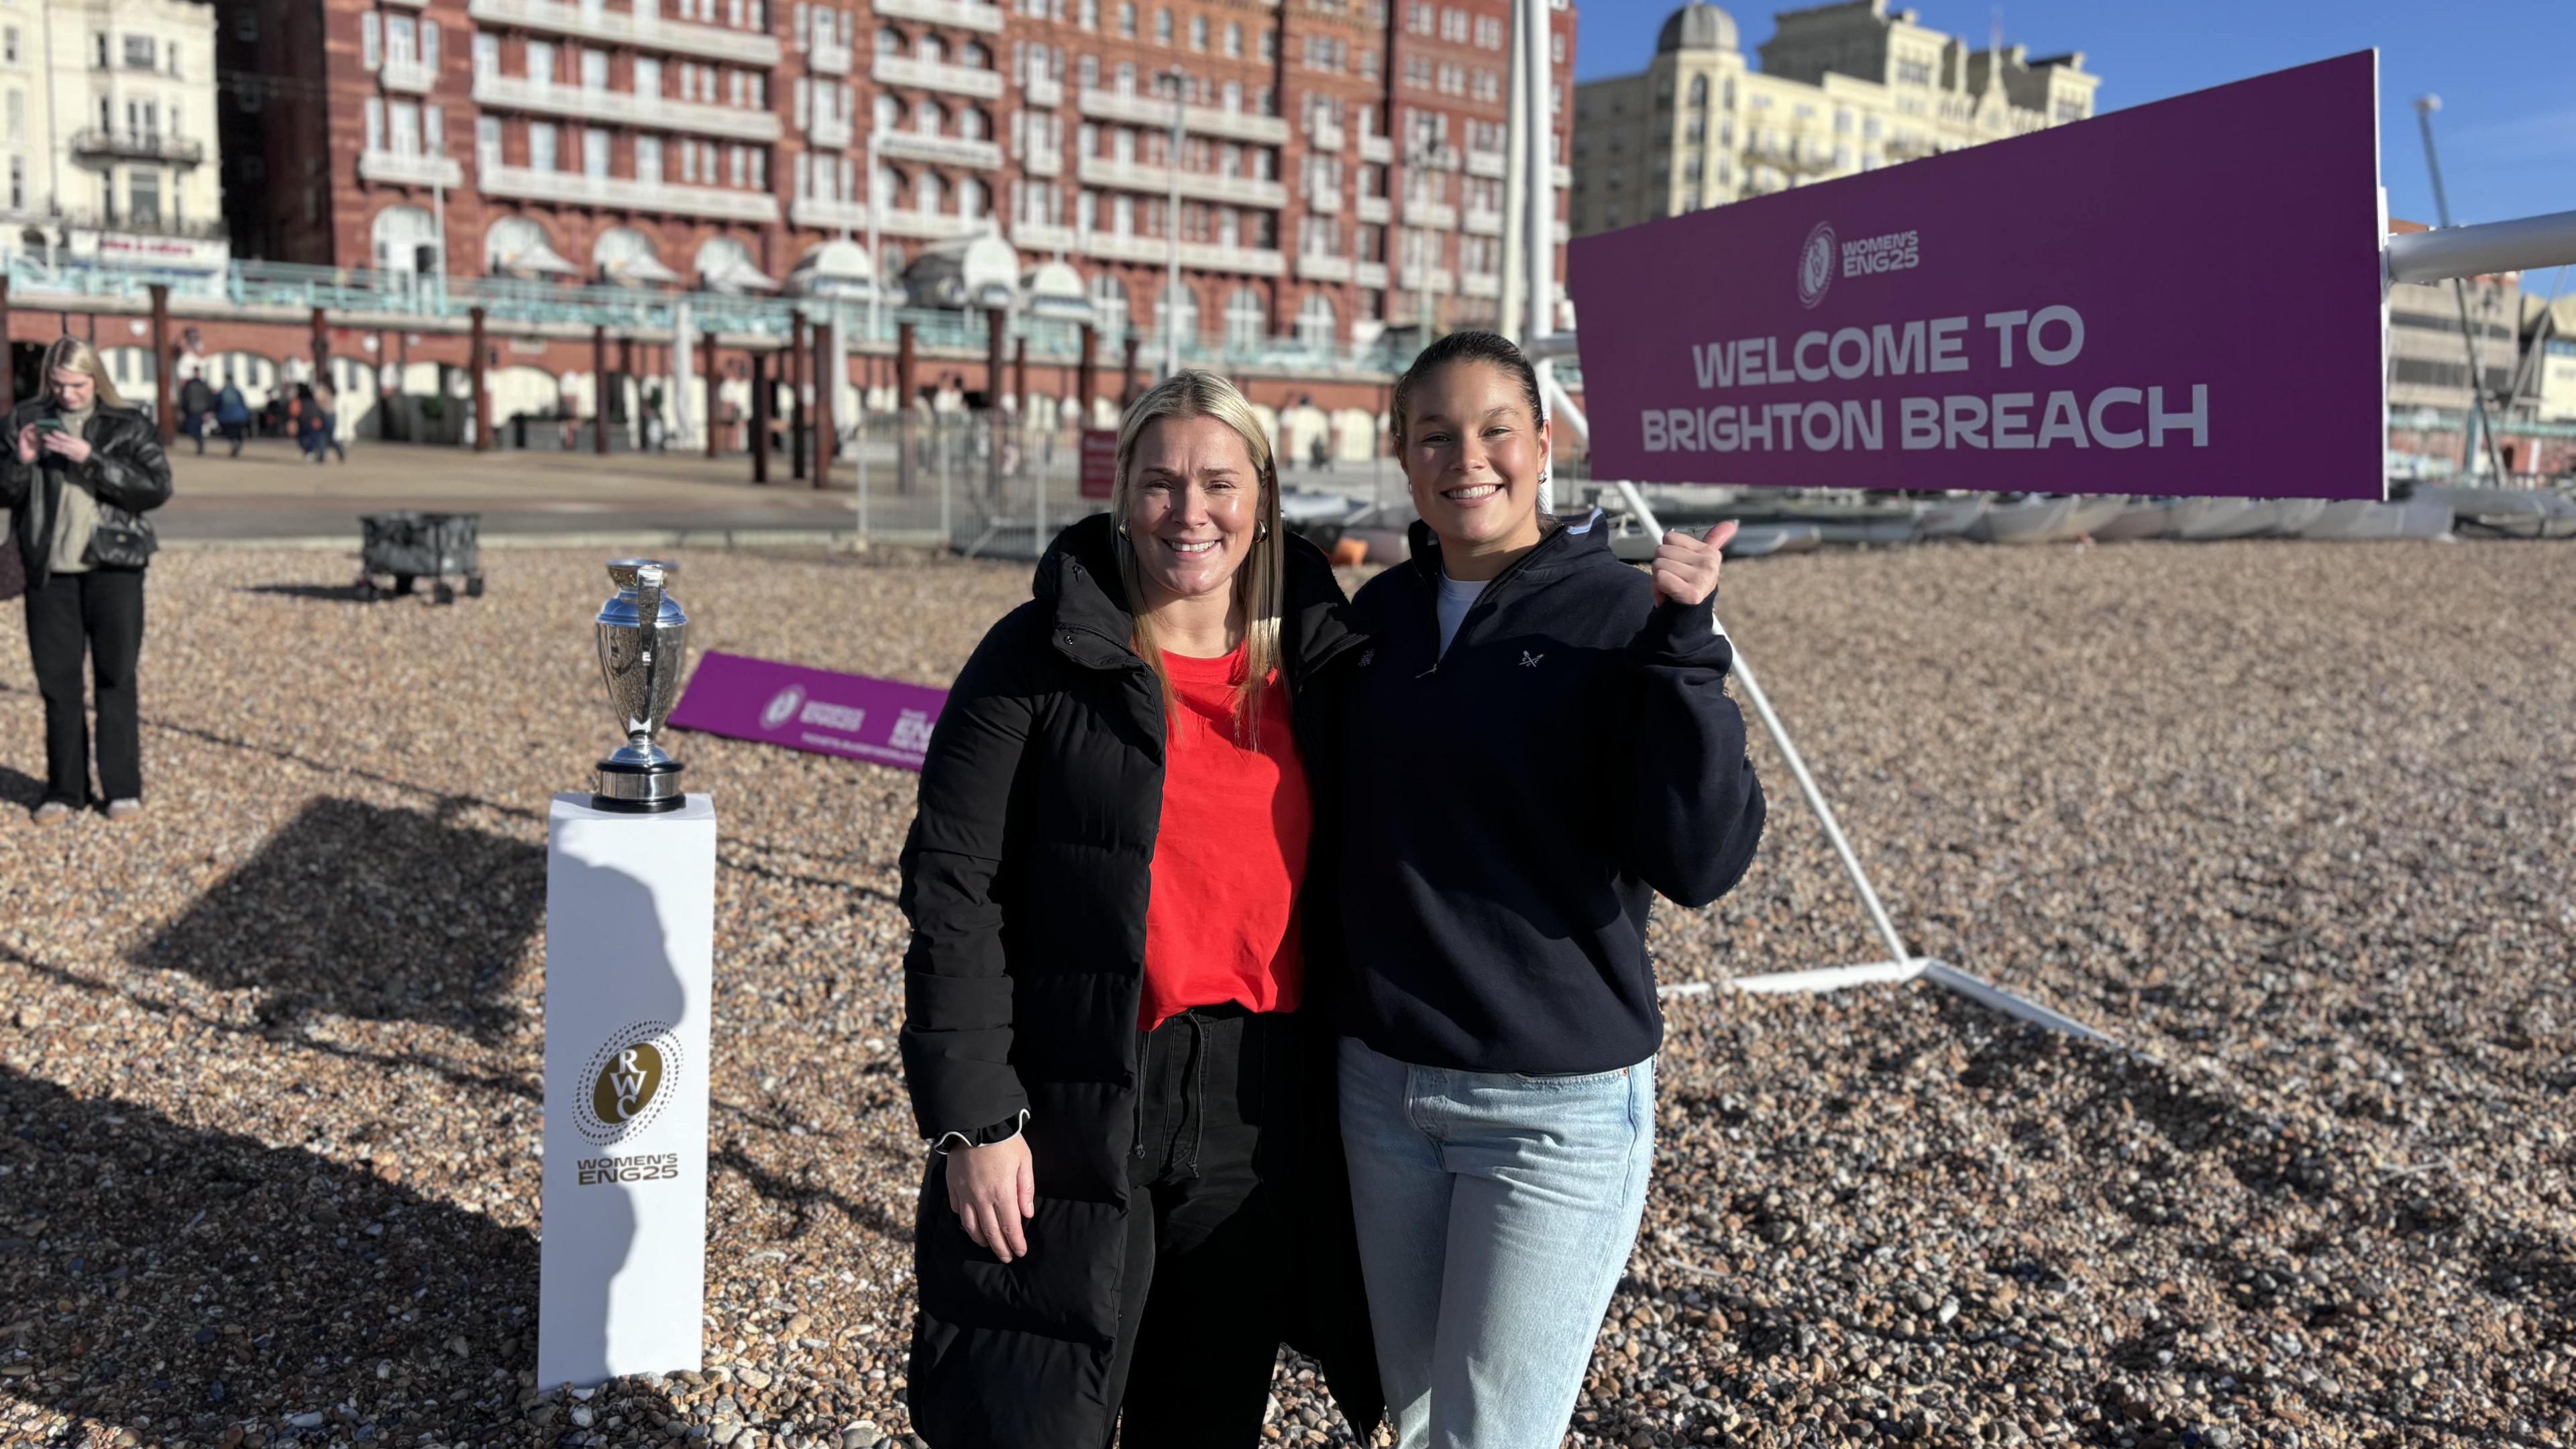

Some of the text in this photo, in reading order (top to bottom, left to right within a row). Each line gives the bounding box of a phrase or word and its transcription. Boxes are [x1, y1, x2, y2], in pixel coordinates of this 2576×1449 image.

[1841, 230, 1919, 257] WOMEN'S
[1843, 246, 1919, 278] ENG25
[1692, 305, 2084, 388] WELCOME TO
[1641, 384, 2208, 452] BRIGHTON BREACH
[577, 1152, 678, 1170] WOMEN'S
[578, 1164, 678, 1185] ENG25
